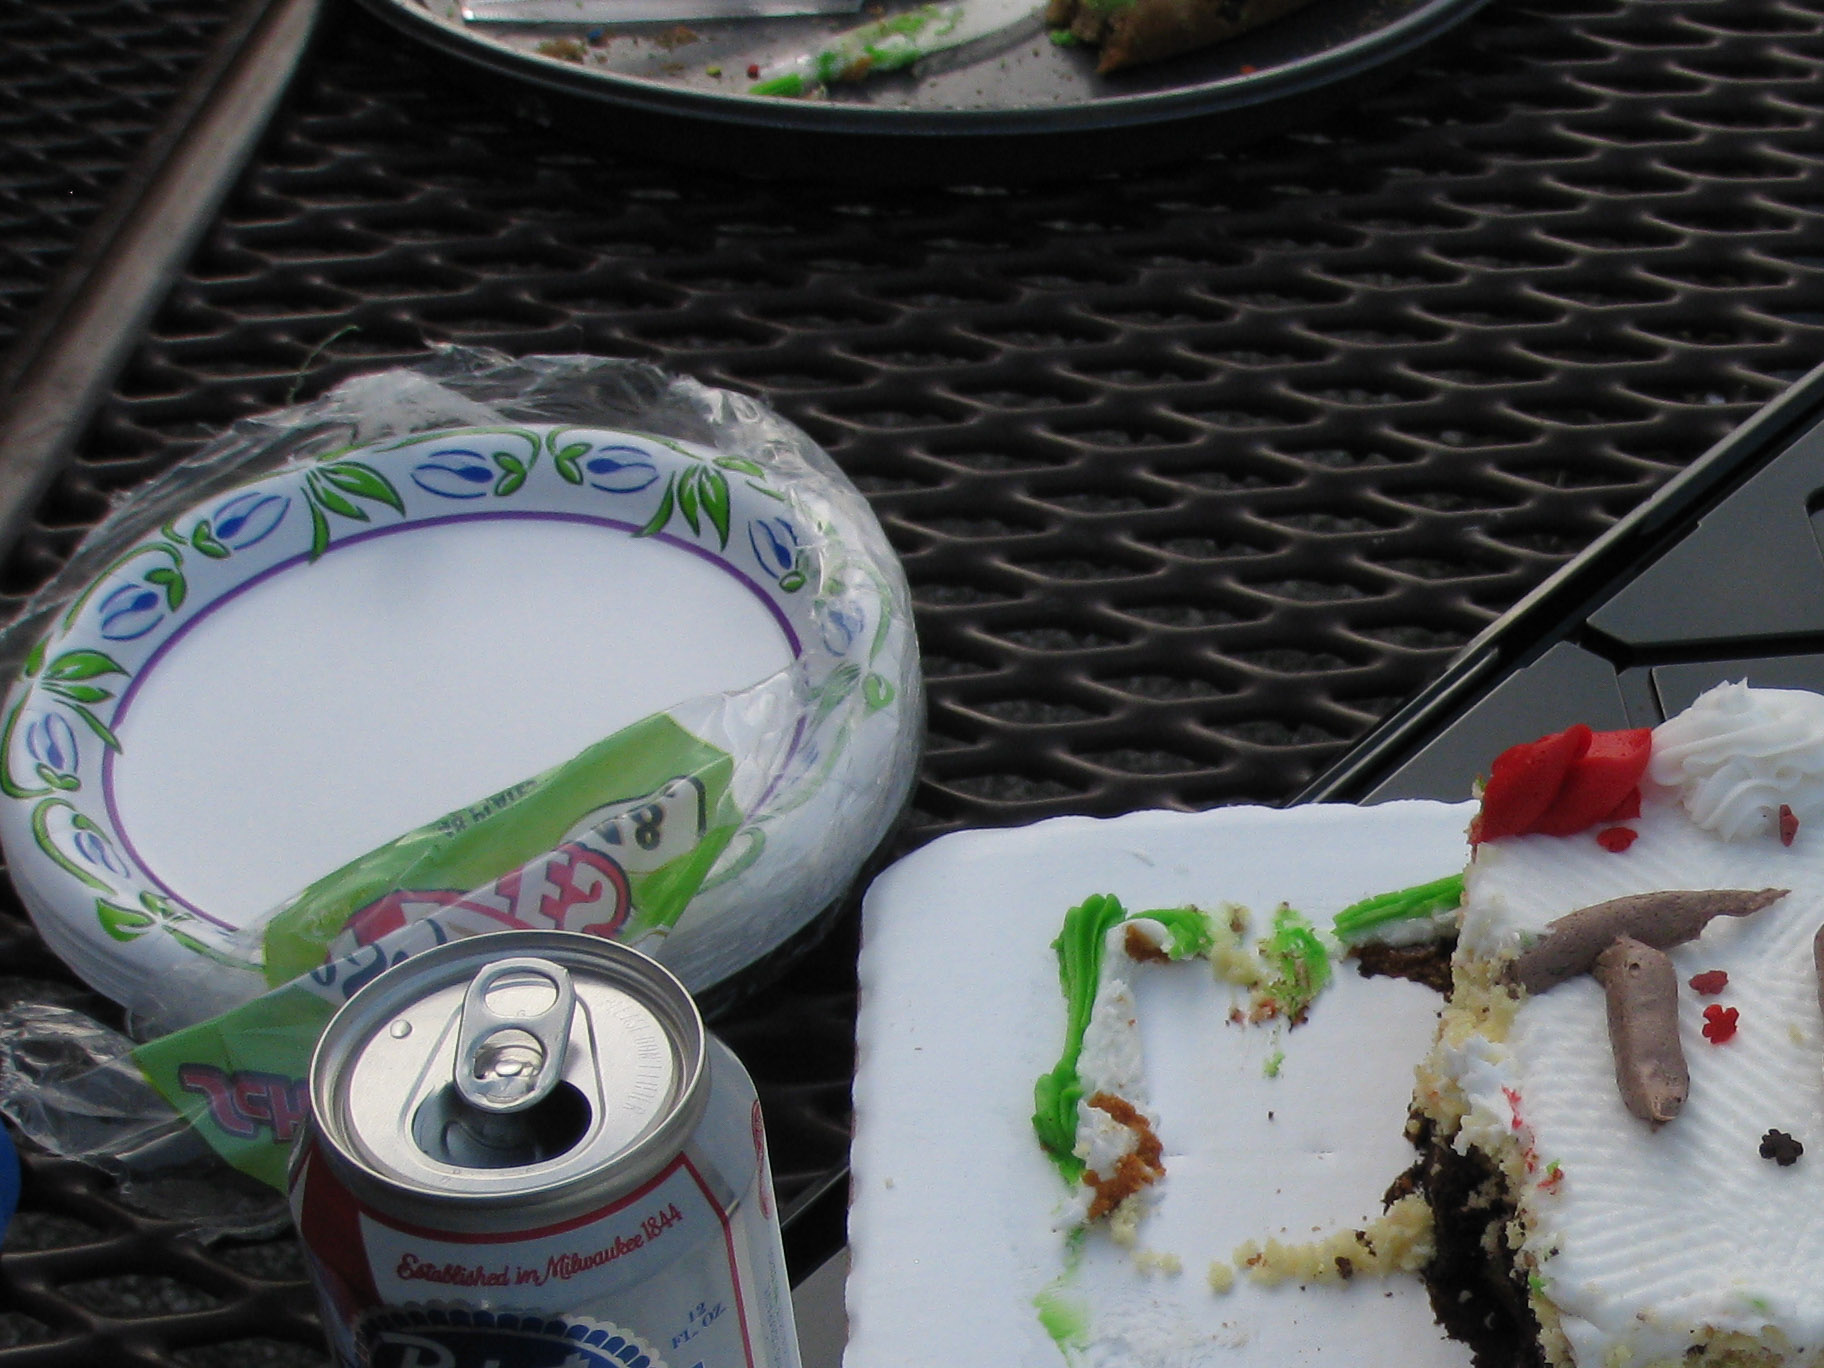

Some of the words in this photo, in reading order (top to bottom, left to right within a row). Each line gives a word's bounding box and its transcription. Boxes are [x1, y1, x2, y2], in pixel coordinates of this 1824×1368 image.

[397, 1253, 509, 1287] Established
[537, 1233, 645, 1286] Milwaukee
[640, 1203, 684, 1241] 1844
[688, 1302, 707, 1324] 12
[700, 1303, 726, 1329] OZ
